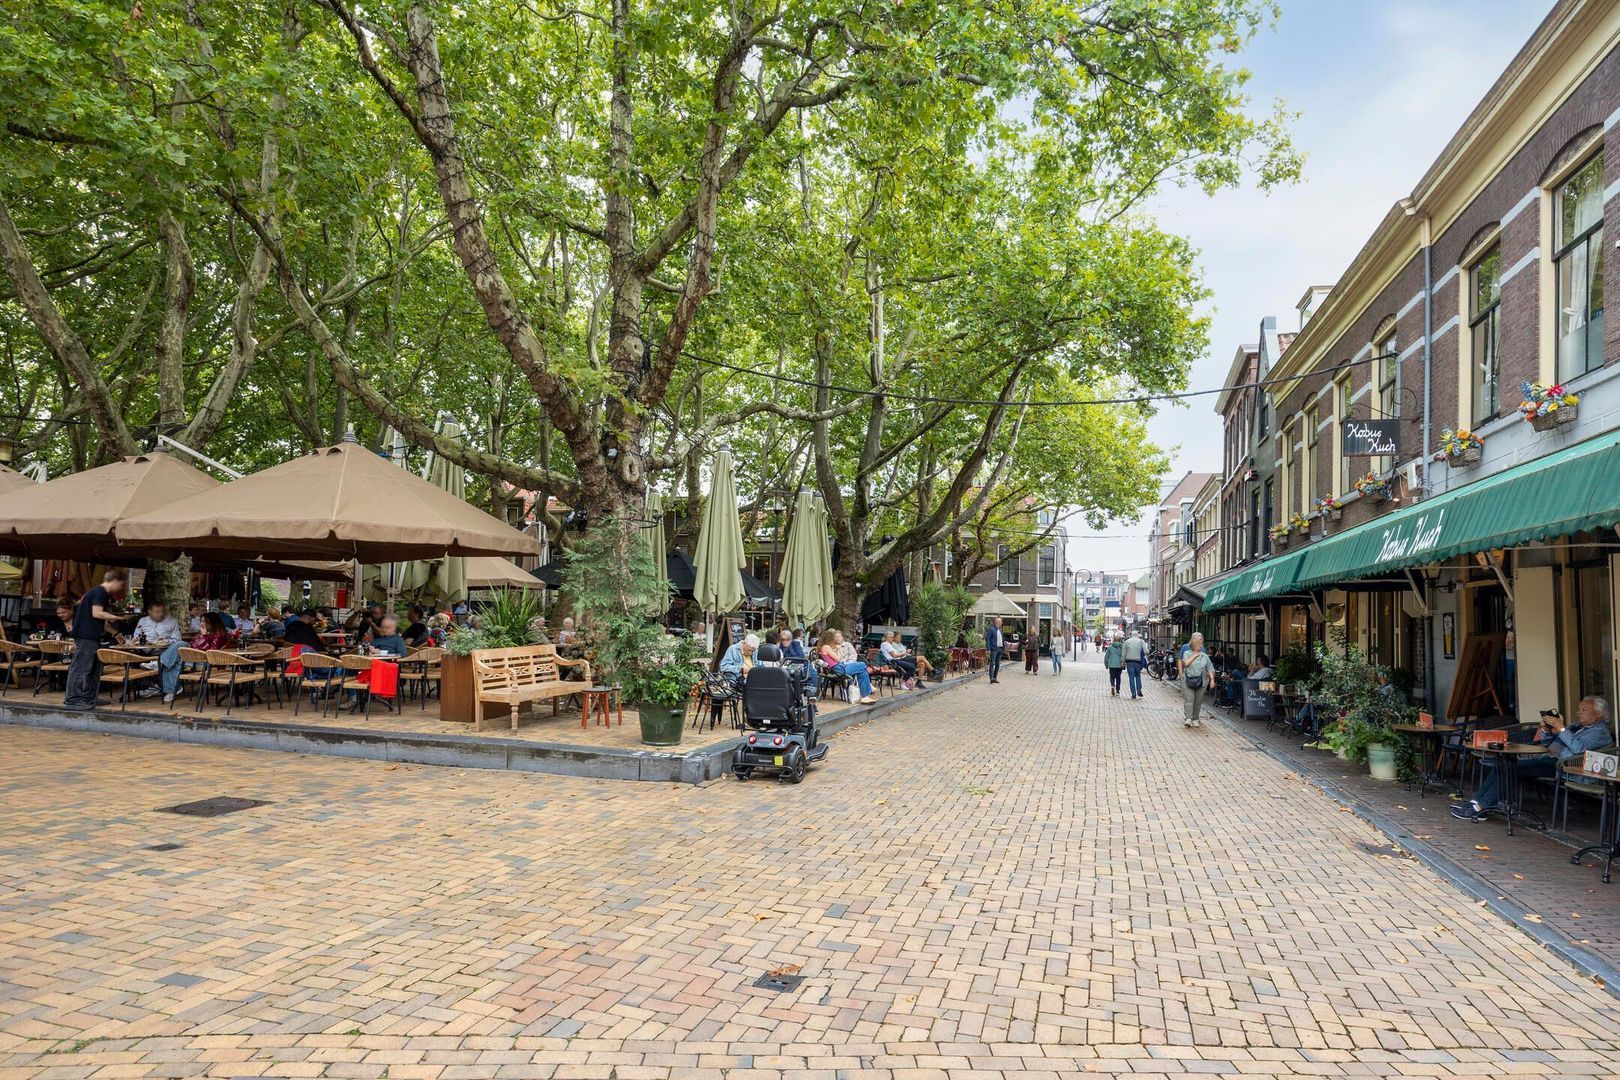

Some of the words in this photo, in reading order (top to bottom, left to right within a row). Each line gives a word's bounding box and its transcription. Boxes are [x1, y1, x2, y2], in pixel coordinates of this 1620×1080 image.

[1347, 423, 1382, 438] Kobus
[1367, 437, 1396, 453] Kuch
[1406, 509, 1445, 557] Kuch
